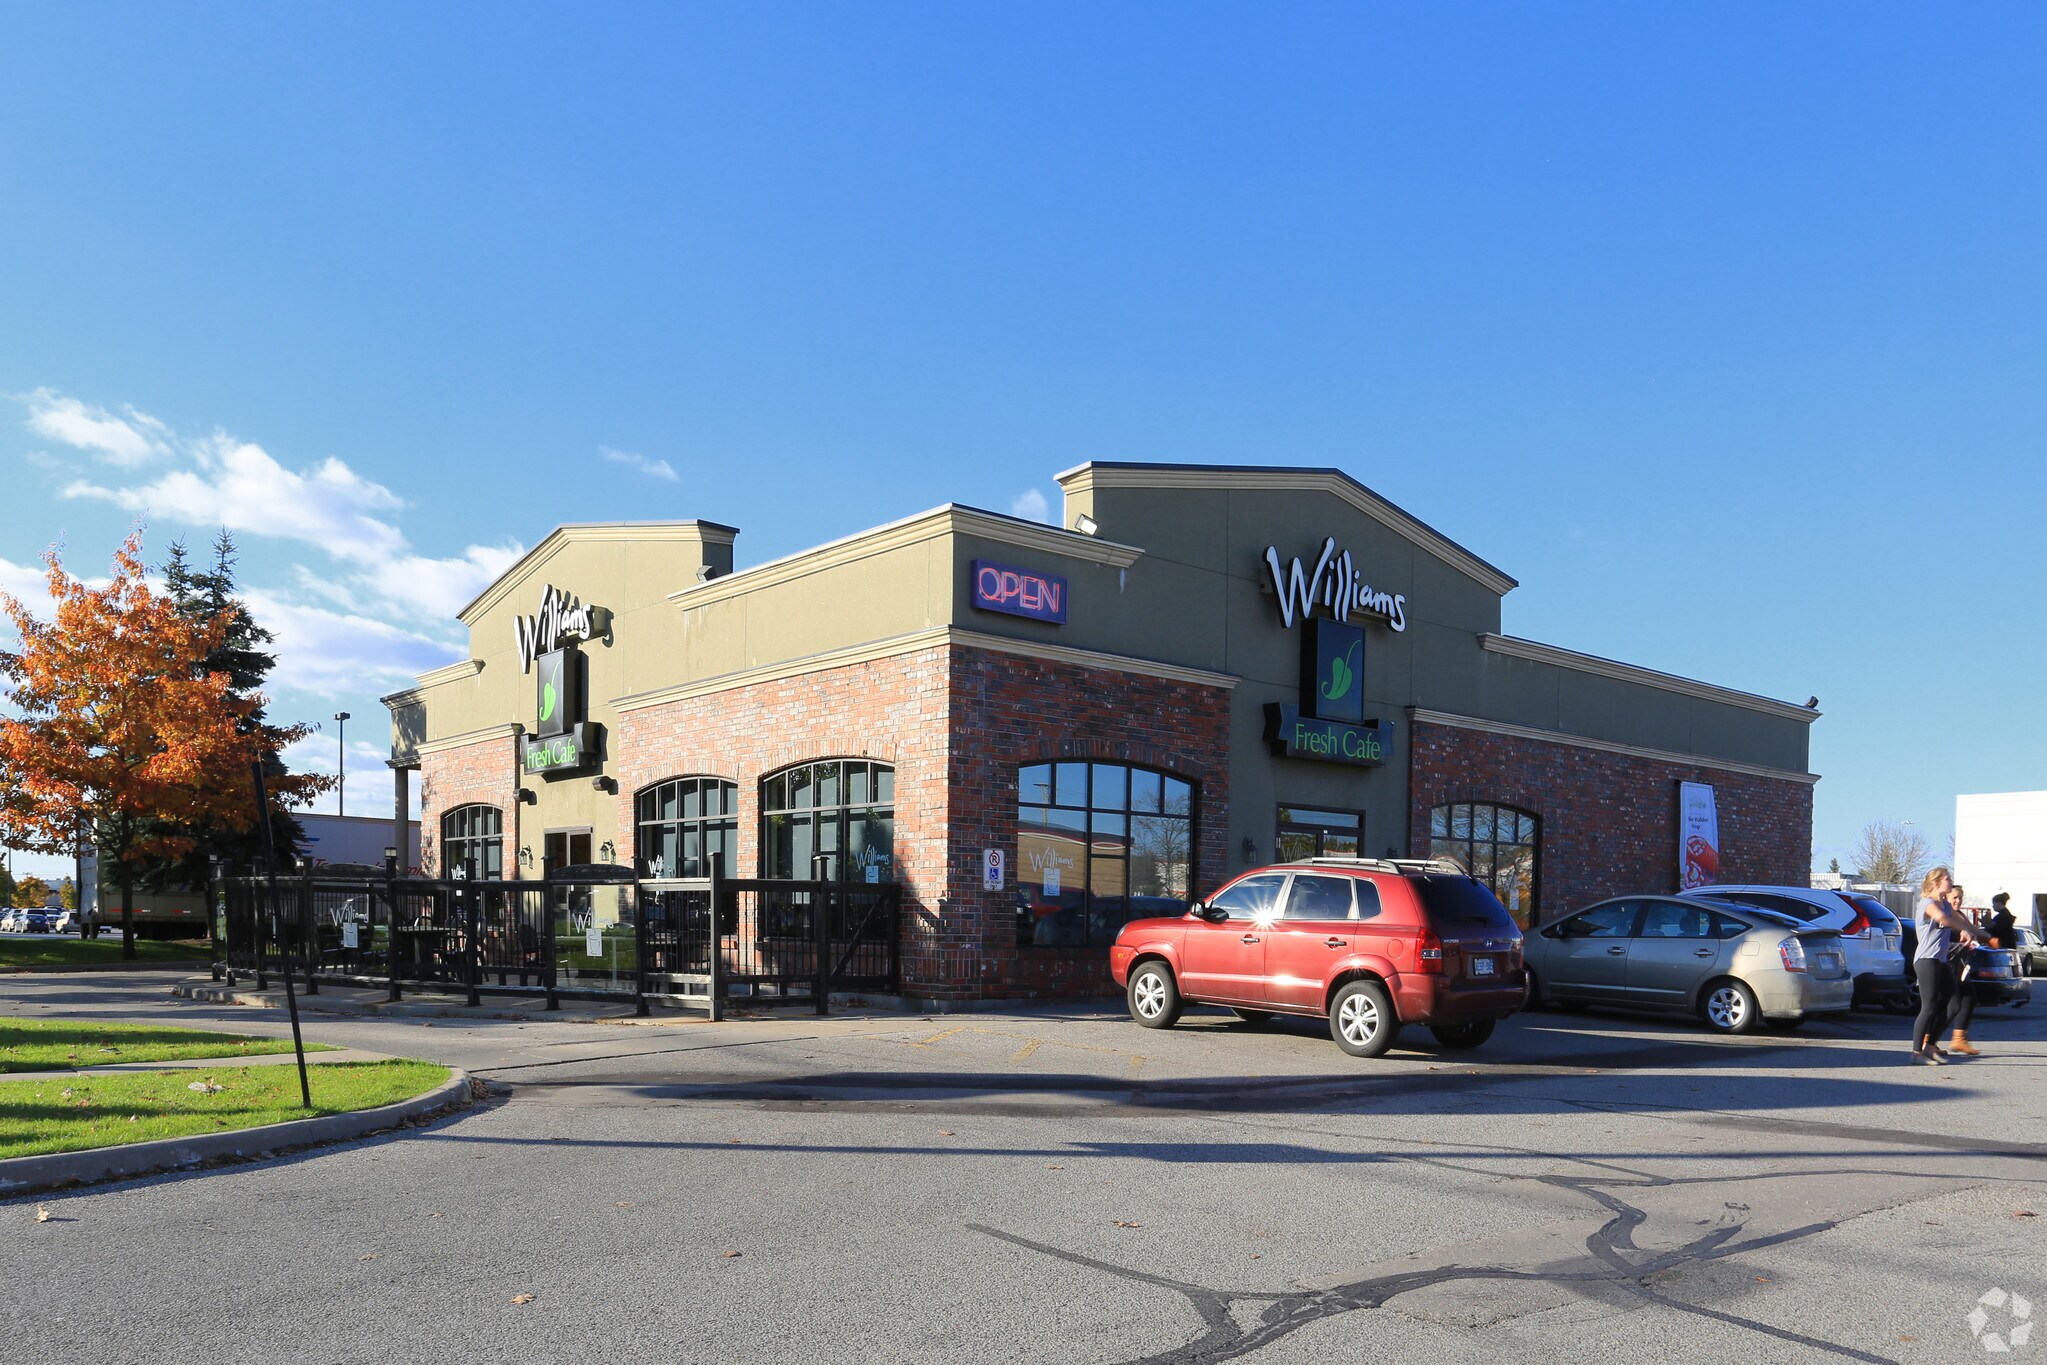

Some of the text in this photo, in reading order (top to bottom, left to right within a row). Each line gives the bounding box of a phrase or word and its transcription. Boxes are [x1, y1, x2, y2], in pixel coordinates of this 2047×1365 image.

[977, 567, 1060, 613] OPEN
[1263, 535, 1407, 633] Williams
[513, 583, 591, 675] Williams
[526, 736, 577, 770] Fresh Cafe
[1294, 722, 1381, 761] Fresh Cafe
[855, 843, 890, 871] Williams
[1028, 846, 1074, 873] Williams
[330, 902, 369, 927] Williams
